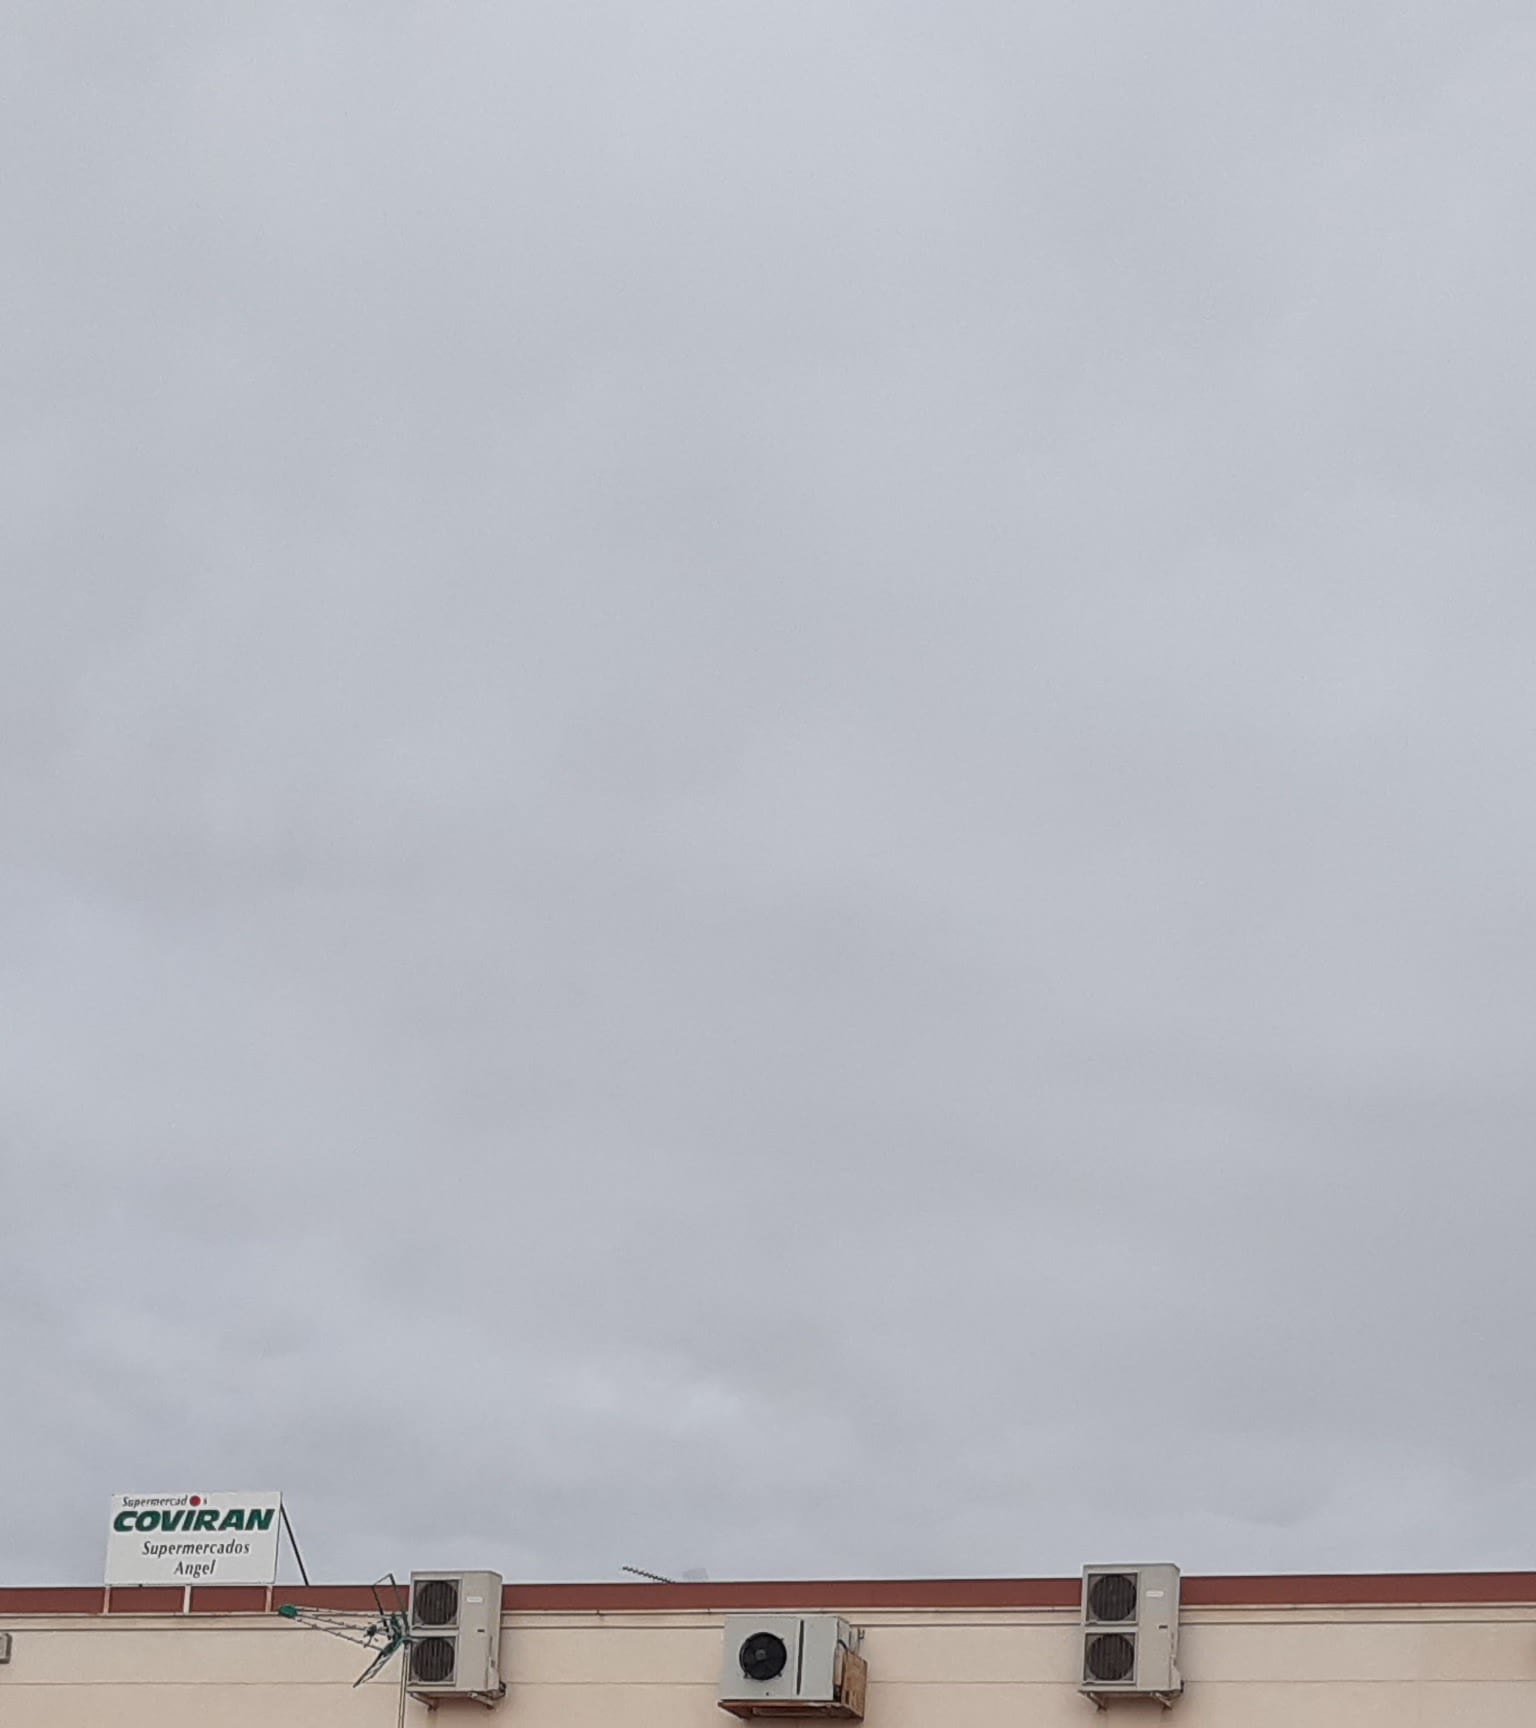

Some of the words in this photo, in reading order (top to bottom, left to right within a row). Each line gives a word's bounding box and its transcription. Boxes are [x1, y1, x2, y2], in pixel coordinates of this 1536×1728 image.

[113, 1508, 275, 1532] COVIRAN
[142, 1539, 250, 1559] Supermercados
[173, 1559, 216, 1578] Angel
